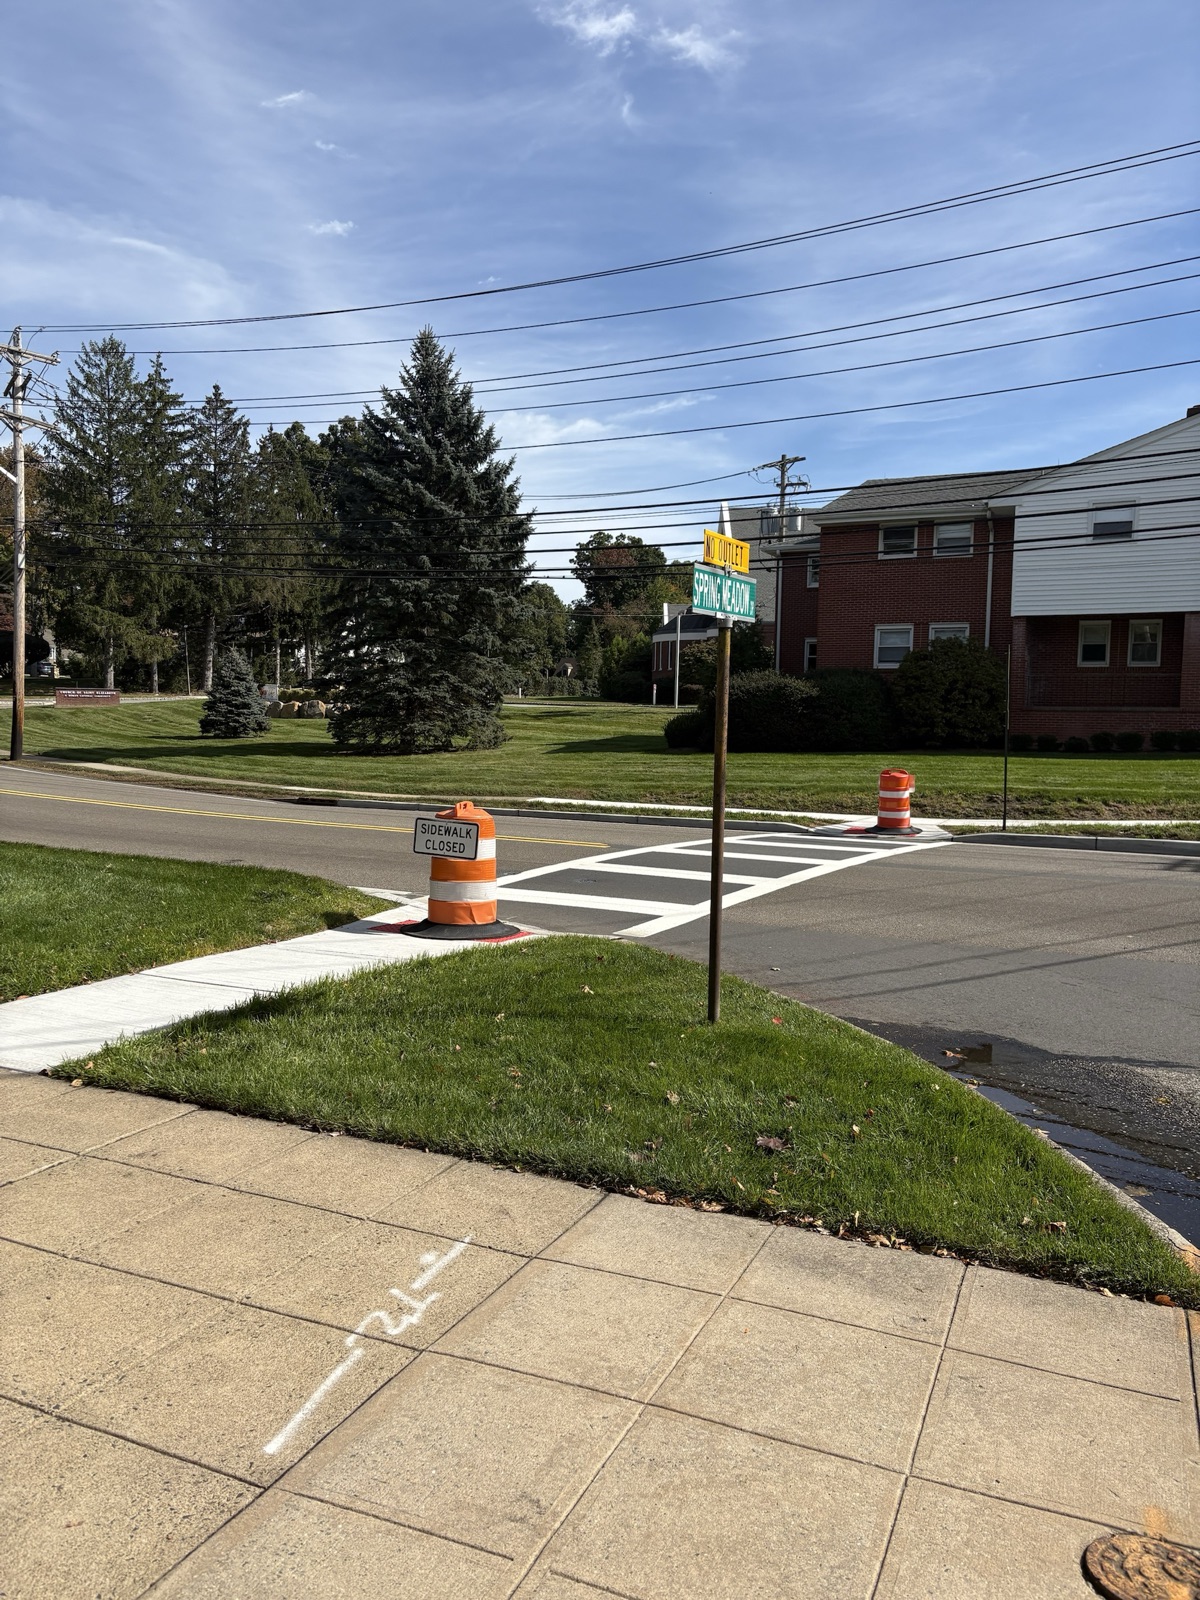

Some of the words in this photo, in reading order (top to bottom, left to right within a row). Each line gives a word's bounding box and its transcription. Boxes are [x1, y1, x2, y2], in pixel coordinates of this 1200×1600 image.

[705, 535, 715, 559] NO
[718, 540, 744, 568] OUTLET
[693, 572, 720, 609] SPRING
[721, 578, 750, 615] MEADOW
[420, 823, 472, 839] SIDEWALK
[425, 839, 466, 854] CLOSED
